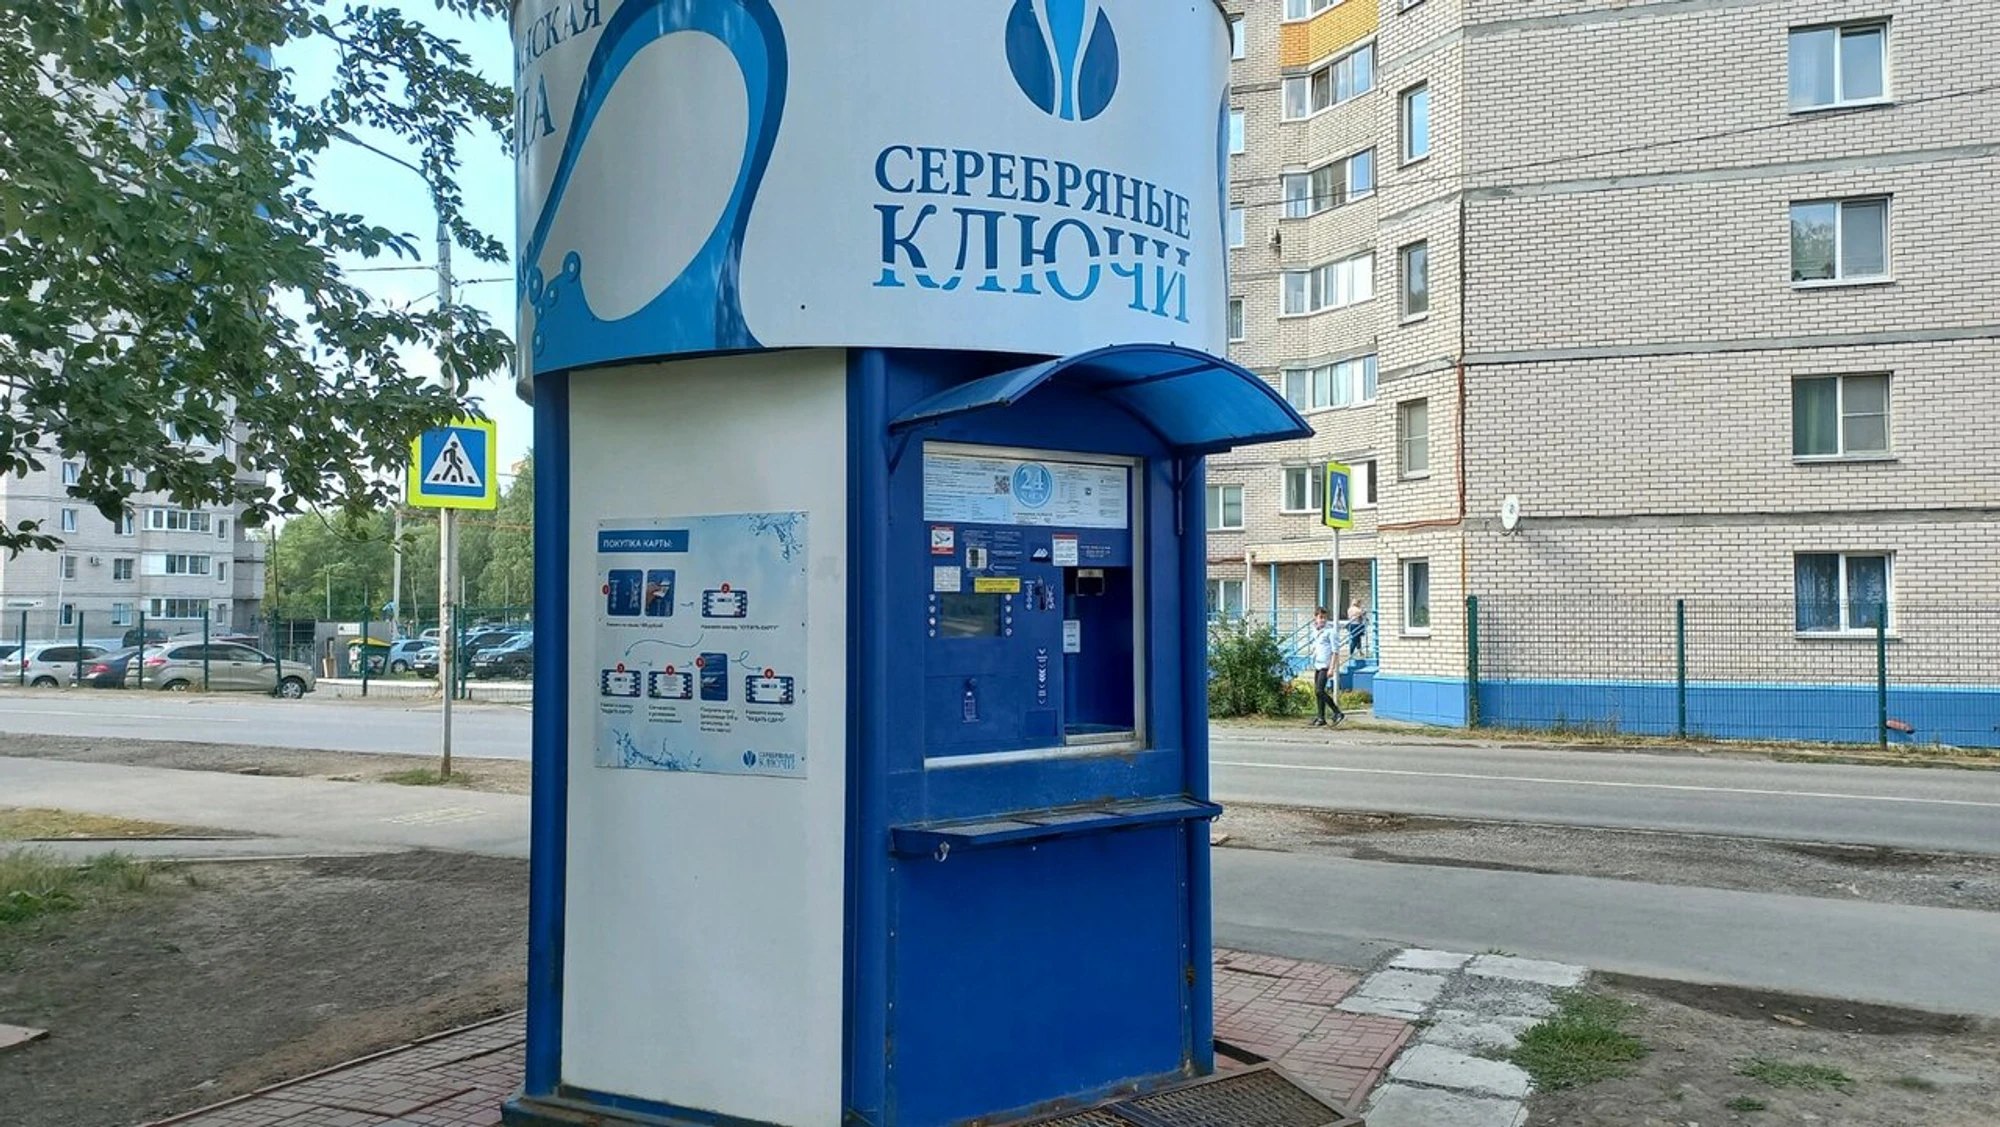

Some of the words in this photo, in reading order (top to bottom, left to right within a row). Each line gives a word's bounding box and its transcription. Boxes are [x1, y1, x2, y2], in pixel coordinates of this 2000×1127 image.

[874, 145, 1190, 240] СЕРЕБРЯНЫЕ
[873, 204, 1190, 324] КЛЮЧИ
[1020, 467, 1044, 490] 24
[603, 539, 641, 548] ПОКУПКА
